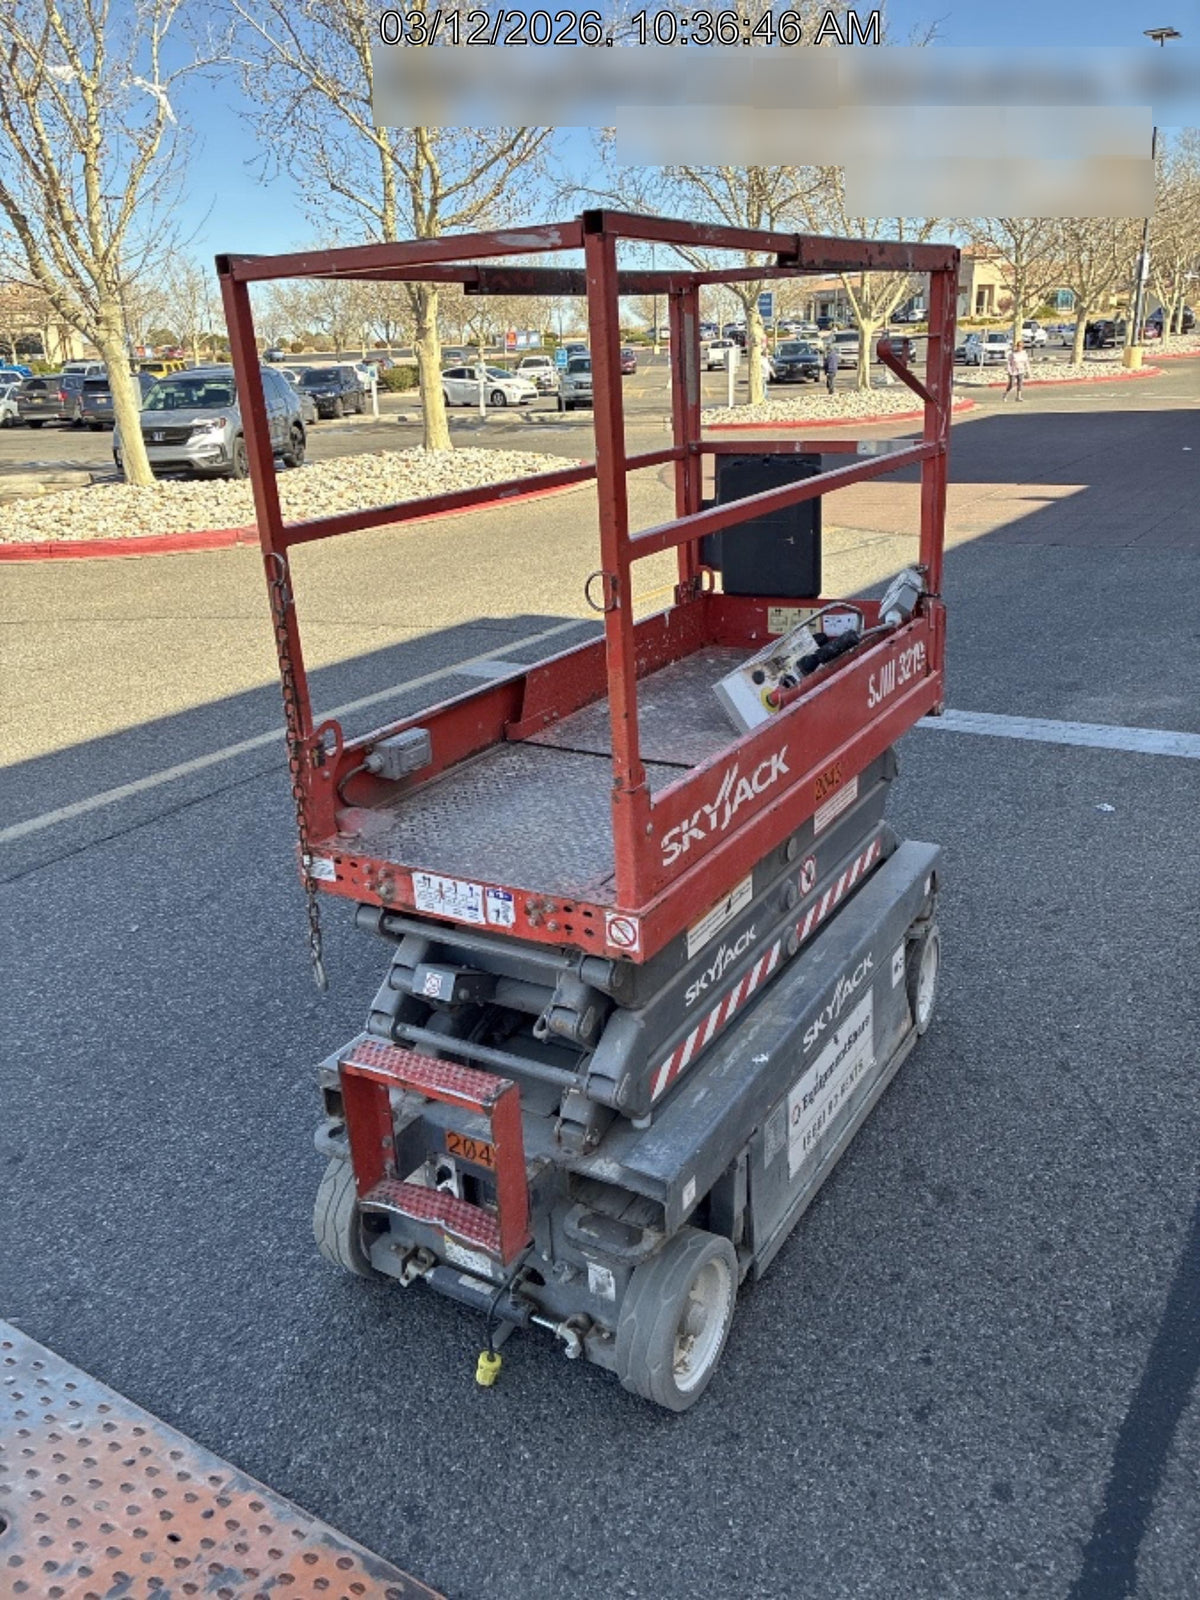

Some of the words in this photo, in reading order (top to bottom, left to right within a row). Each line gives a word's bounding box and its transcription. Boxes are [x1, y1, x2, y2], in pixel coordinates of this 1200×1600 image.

[661, 744, 790, 867] SKYJACK
[685, 923, 757, 1007] SKYJACK
[803, 951, 874, 1053] SKYJACK
[447, 1131, 497, 1168] 204
